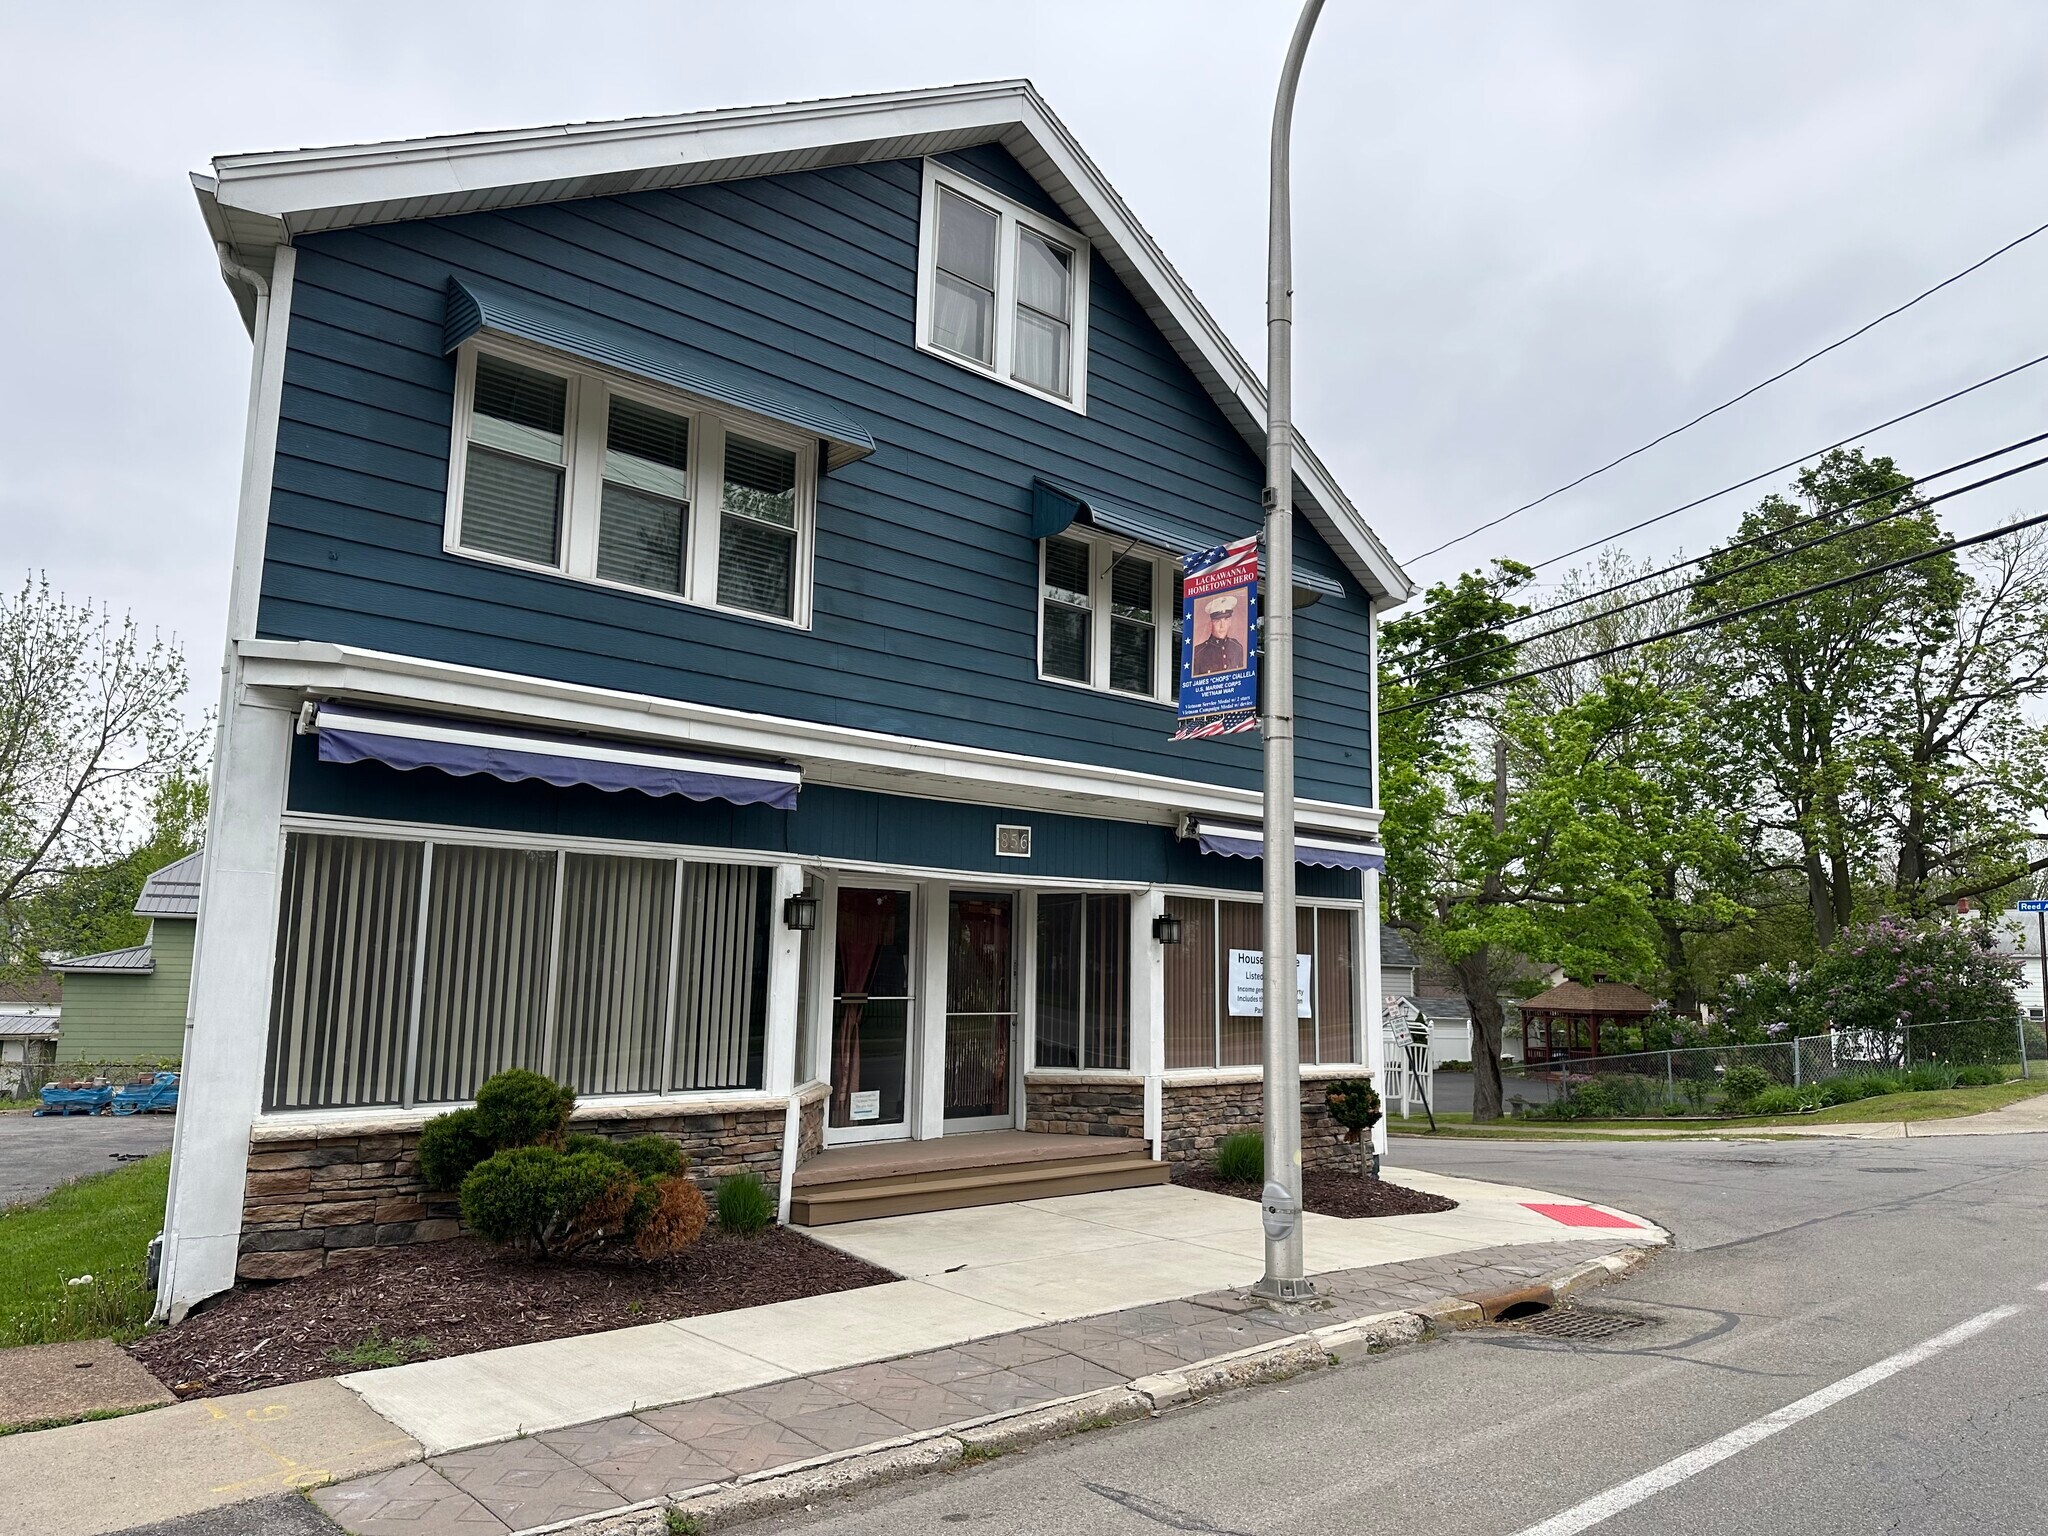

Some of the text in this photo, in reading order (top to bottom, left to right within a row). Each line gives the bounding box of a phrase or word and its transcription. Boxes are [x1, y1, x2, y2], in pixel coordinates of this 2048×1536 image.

[1195, 566, 1247, 586] LACKAWANNA
[1187, 572, 1254, 596] HOMETOWN HERO
[1192, 678, 1209, 687] JAMES
[1224, 680, 1242, 688] CORPS
[1001, 832, 1028, 849] 856
[1238, 953, 1263, 965] House
[1237, 985, 1255, 993] Income
[1237, 995, 1259, 1003] Includes
